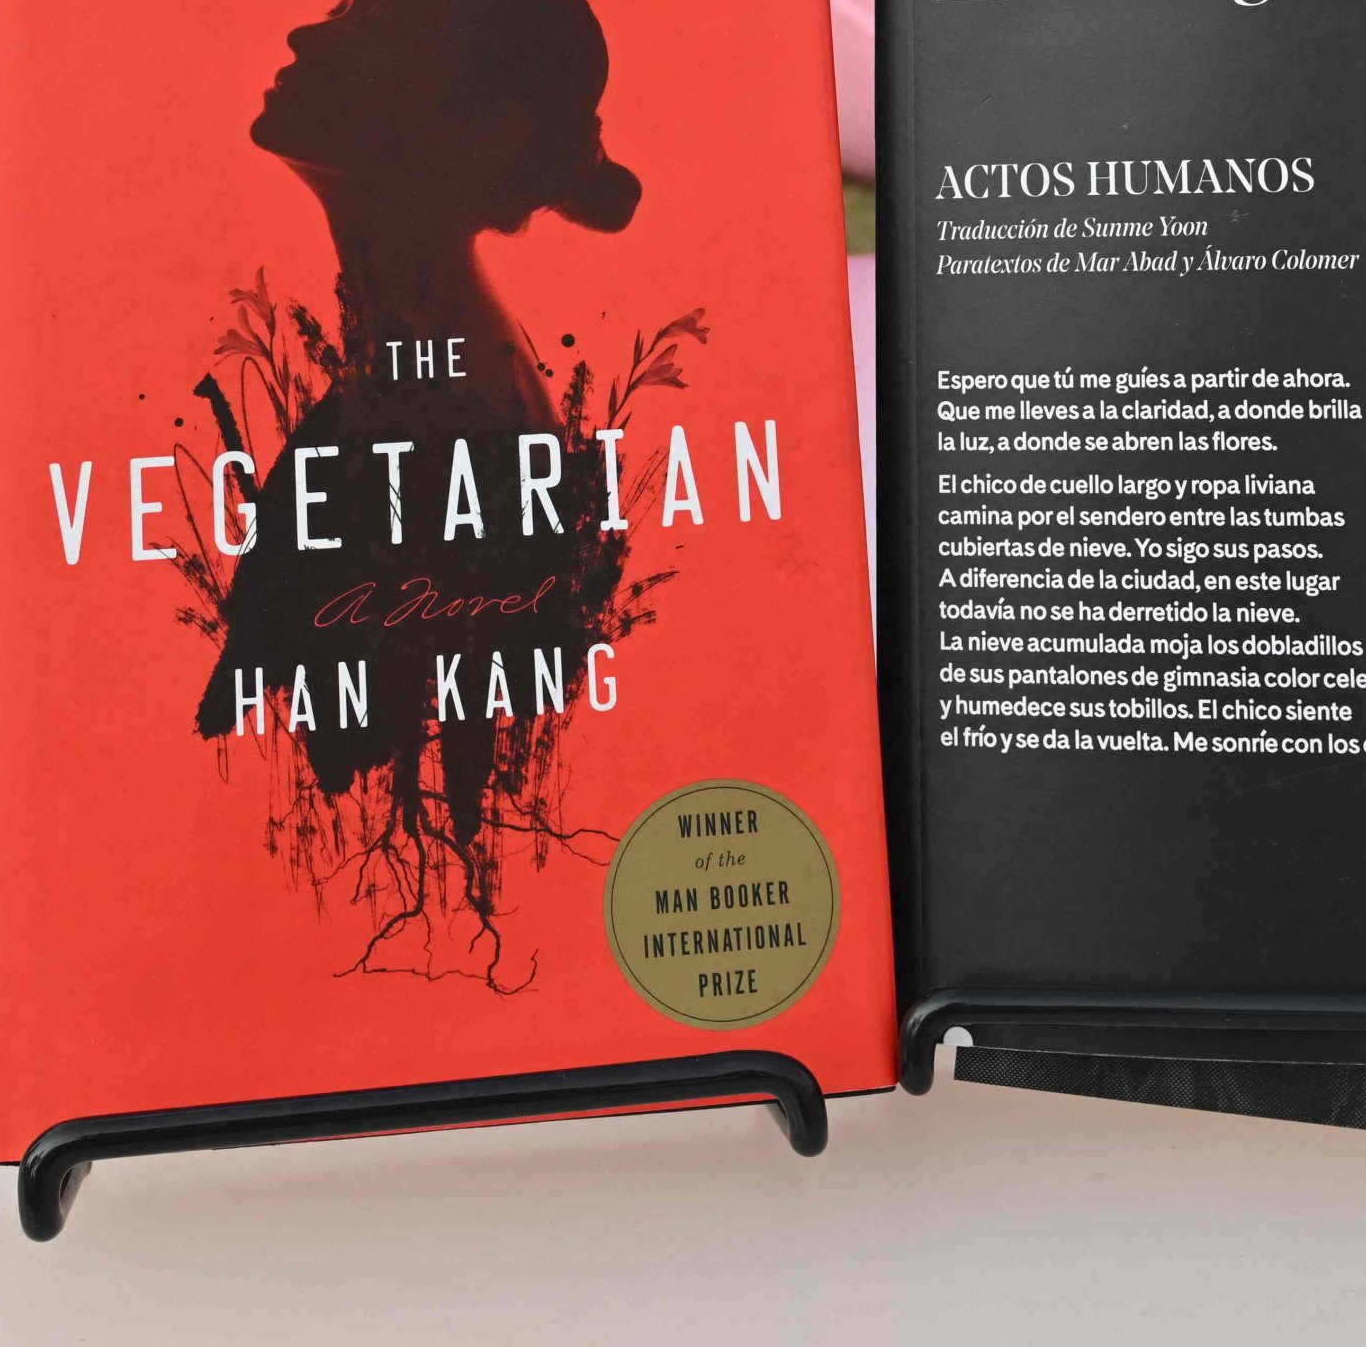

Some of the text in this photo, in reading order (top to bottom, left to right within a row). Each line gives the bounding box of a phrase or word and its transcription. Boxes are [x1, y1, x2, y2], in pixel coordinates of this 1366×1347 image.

[936, 158, 1314, 199] ACTOS HUMANOS
[938, 216, 1207, 240] Traducción de Sunme Yoon
[937, 245, 1359, 276] Paratextos de Mar Abad y Álvaro Colomer
[386, 338, 466, 380] THE
[938, 366, 1350, 394] Espero que tú me guíes a partir de ahora.
[937, 399, 1362, 422] Que me lleves a la claridad, a donde brilla
[50, 420, 781, 565] VEGETARIAN
[938, 505, 1345, 530] camina por el sendero entre las tumbas
[383, 575, 557, 629] Novel
[233, 642, 619, 738] HAN KANG
[940, 663, 966, 682] de
[969, 668, 1004, 683] sus
[1009, 665, 1128, 689] pantalones
[1131, 666, 1158, 686] de
[1164, 665, 1261, 692] gimnasia
[1264, 668, 1320, 688] color
[678, 810, 757, 838] WINNER
[695, 851, 745, 871] of the
[656, 881, 789, 914] MAN BOOKER
[643, 921, 807, 960] INTERNATIONAL
[699, 970, 757, 997] PRIZE
